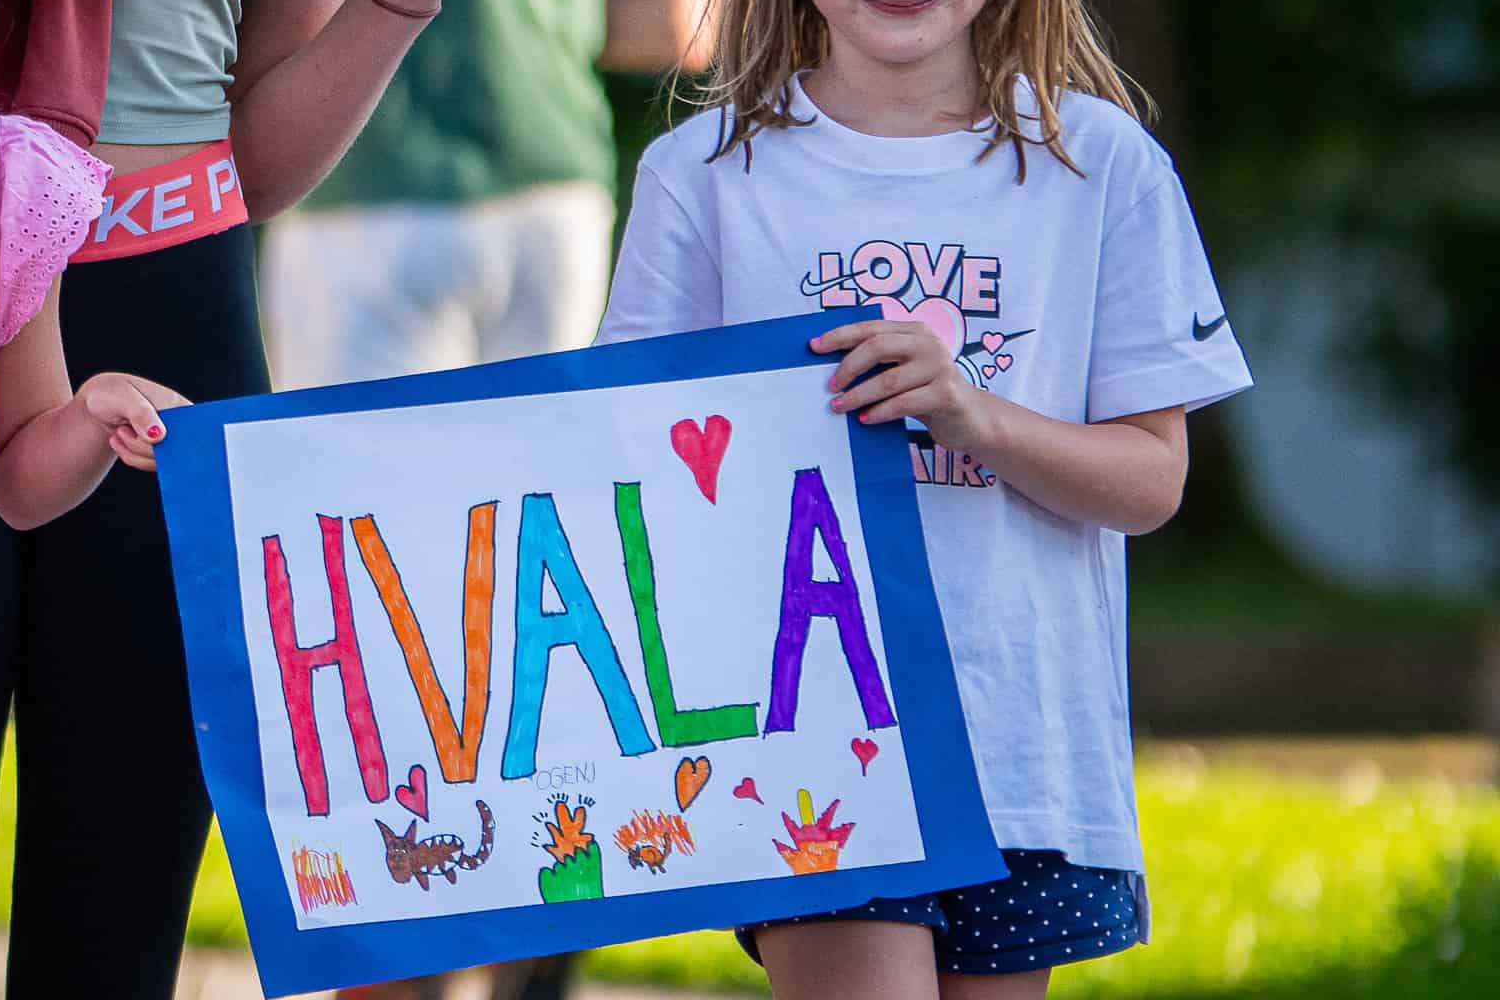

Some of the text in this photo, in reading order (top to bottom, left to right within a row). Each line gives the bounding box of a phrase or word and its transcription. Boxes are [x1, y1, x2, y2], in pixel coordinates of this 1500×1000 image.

[206, 153, 243, 213] P
[818, 240, 1000, 318] LOVE
[262, 467, 898, 816] HVALA
